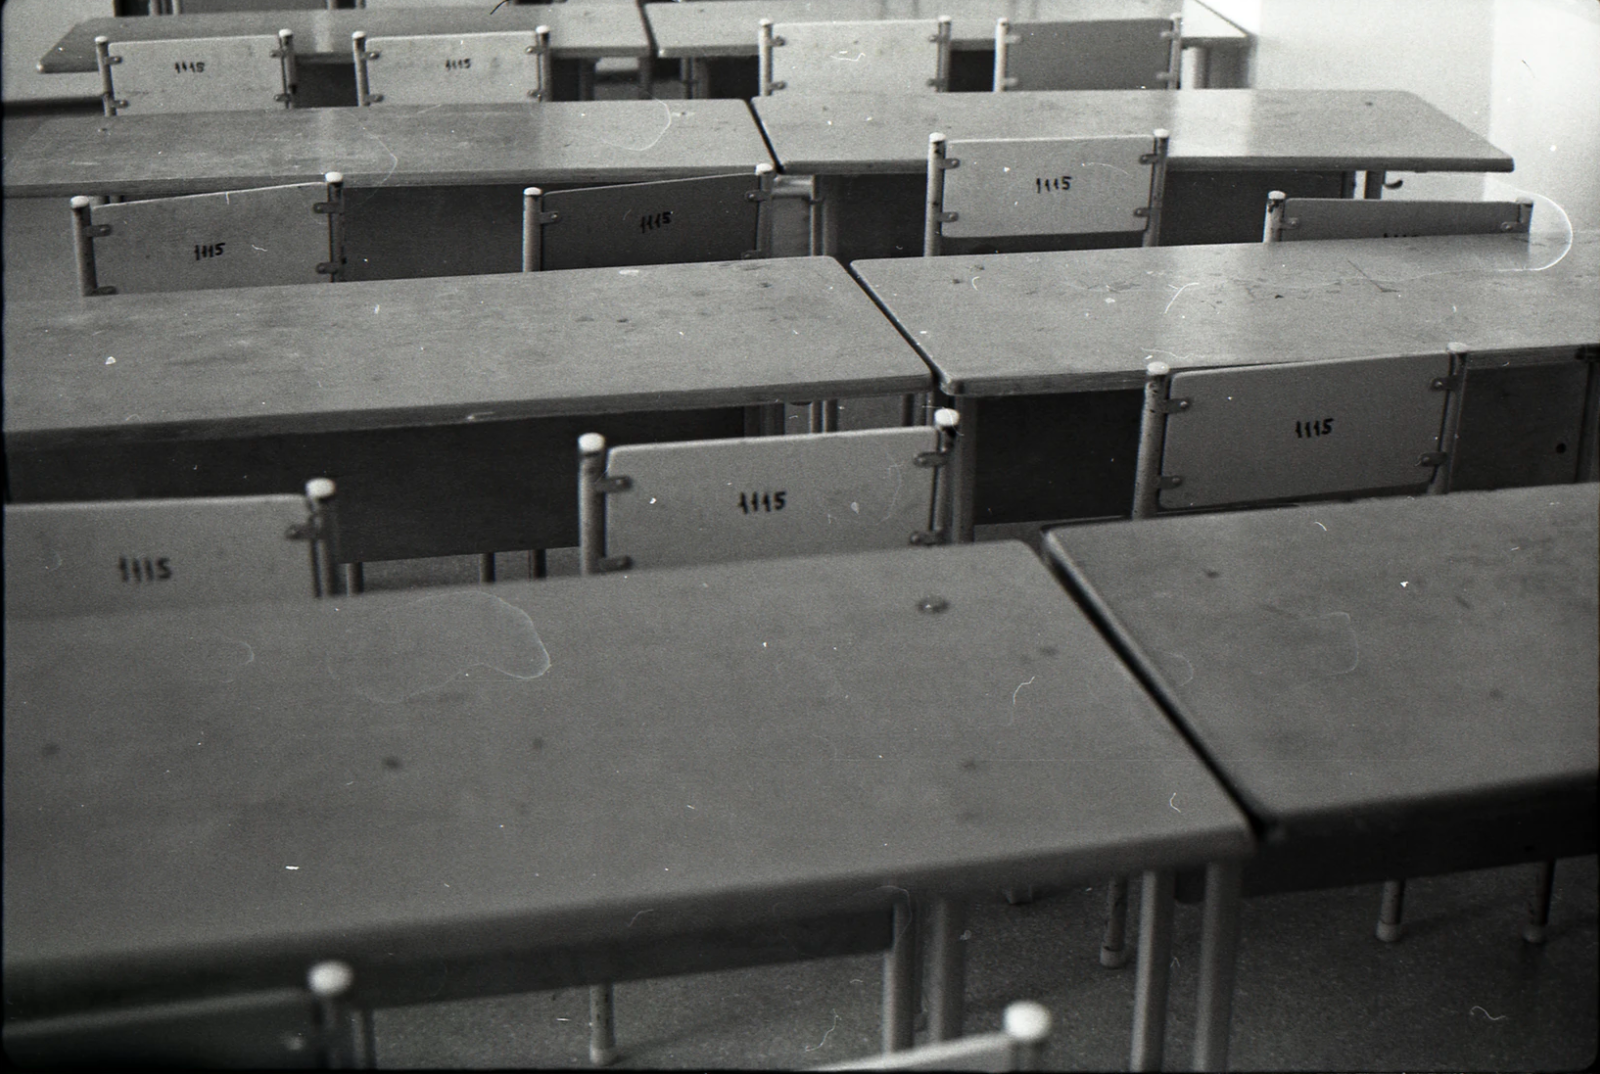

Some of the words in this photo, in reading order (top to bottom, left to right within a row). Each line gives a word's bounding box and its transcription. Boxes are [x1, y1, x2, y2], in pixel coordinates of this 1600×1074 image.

[1036, 176, 1072, 194] 1115
[640, 211, 671, 233] 1115
[194, 242, 226, 261] 1115
[1295, 417, 1334, 438] 1115
[738, 490, 786, 514] 1115
[118, 557, 172, 583] 1115
